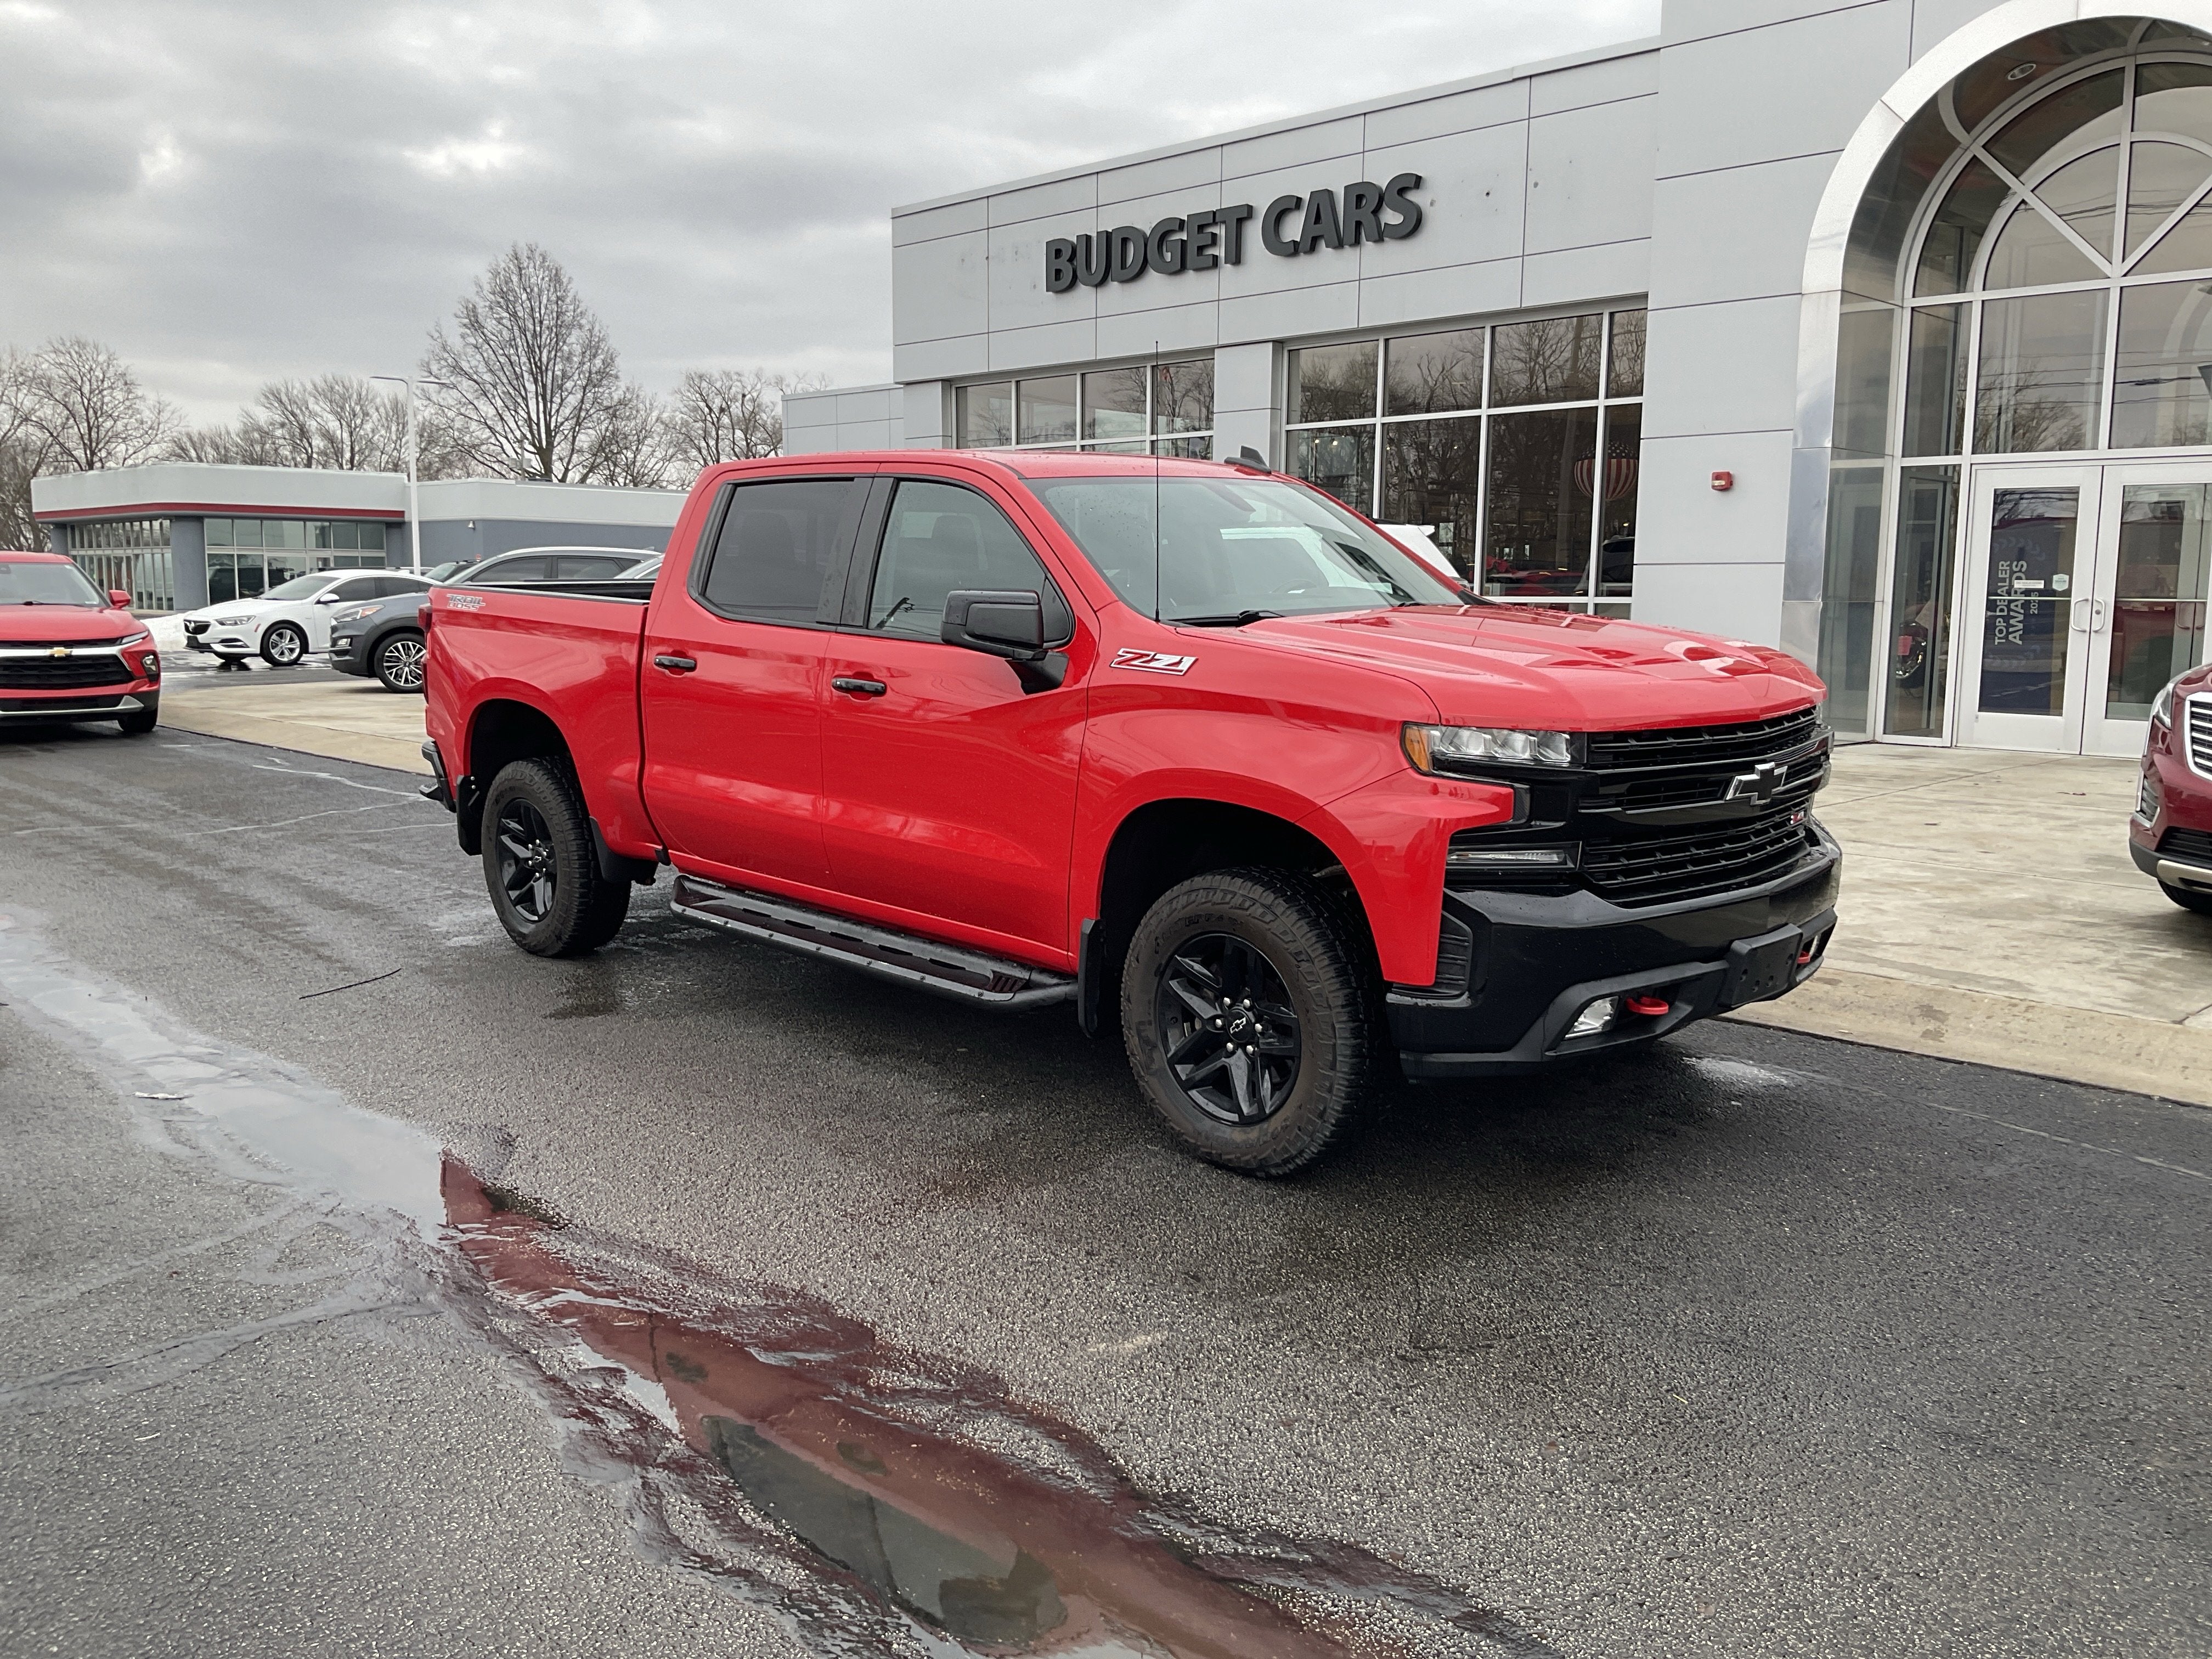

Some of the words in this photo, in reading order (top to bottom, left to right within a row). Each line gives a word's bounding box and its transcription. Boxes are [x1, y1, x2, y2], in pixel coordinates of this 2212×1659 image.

[1046, 203, 1252, 293] BUDGET
[1261, 172, 1423, 256] CARS
[447, 594, 486, 606] TRAIL
[1996, 561, 2010, 616] DEALER
[2008, 560, 2027, 645] AWARDS
[447, 602, 479, 612] BOSS
[1994, 618, 2006, 645] TOP
[1109, 648, 1199, 676] Z71
